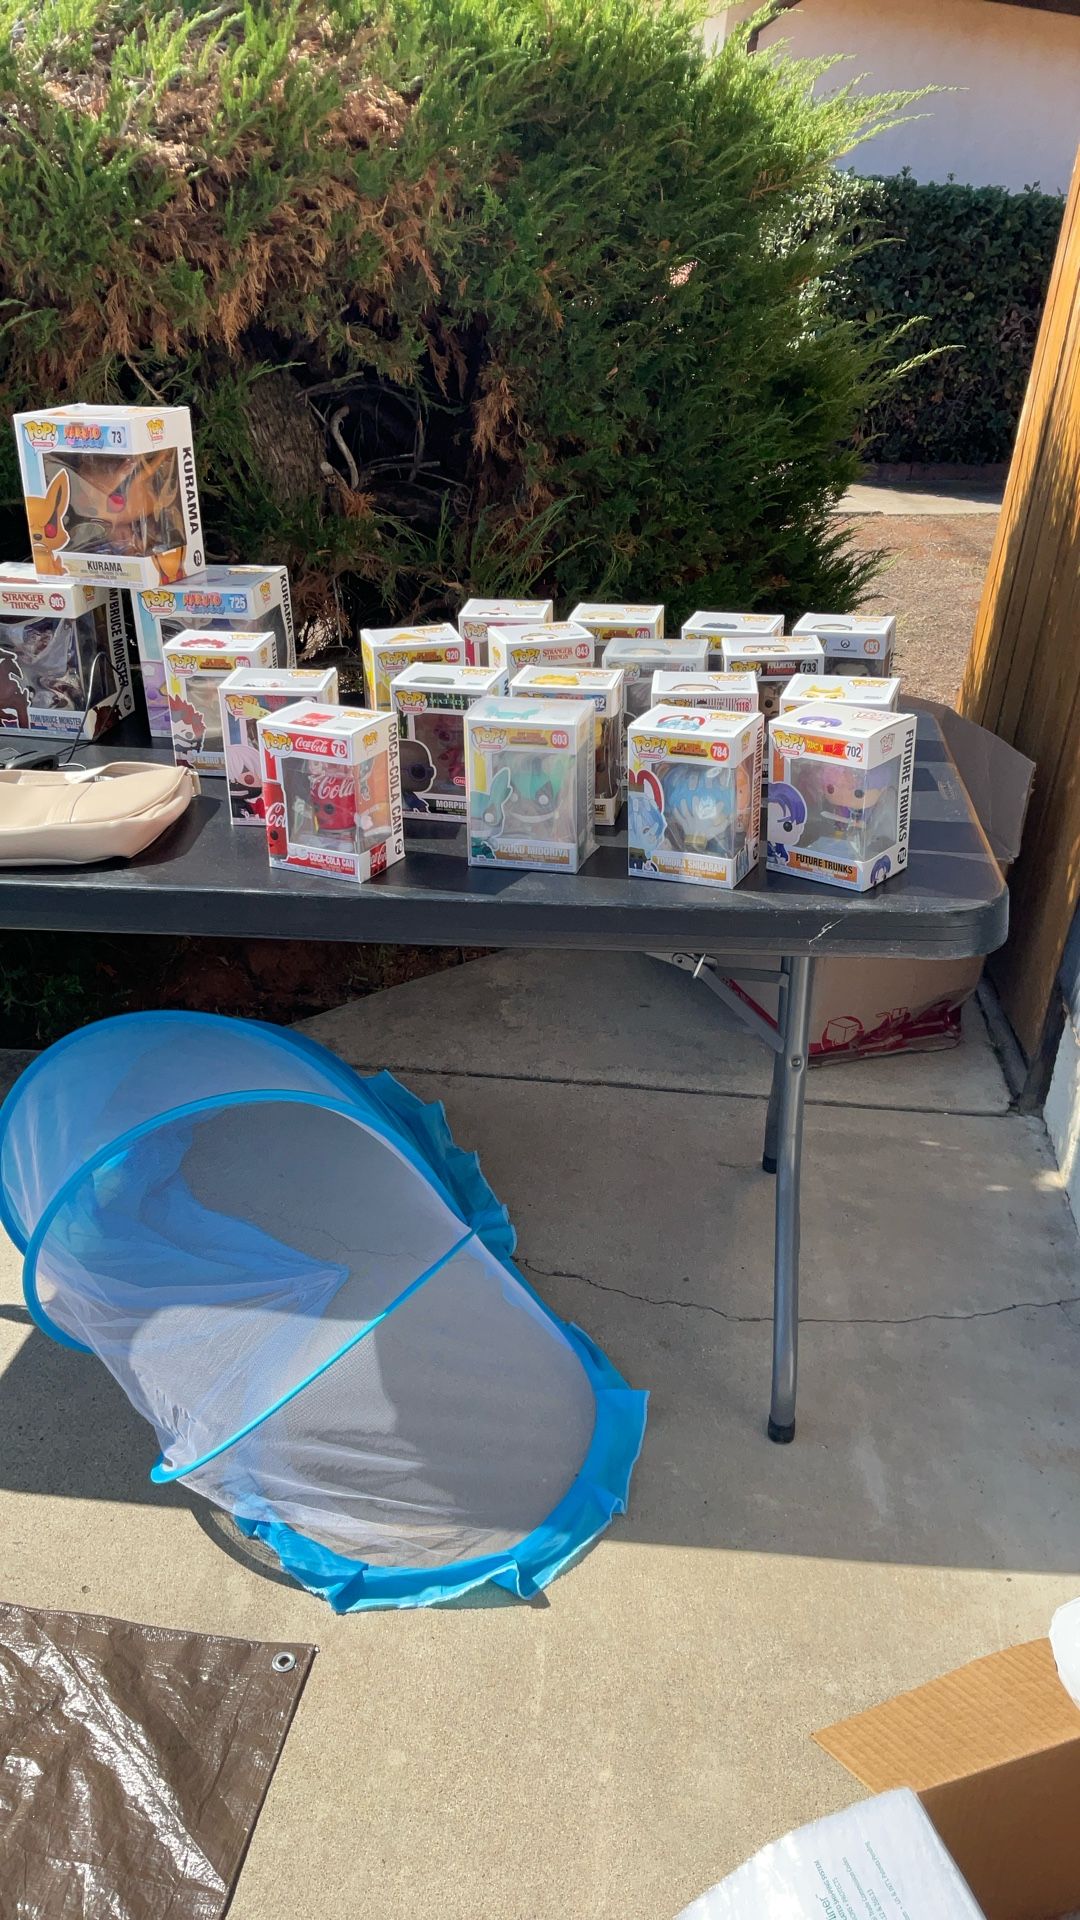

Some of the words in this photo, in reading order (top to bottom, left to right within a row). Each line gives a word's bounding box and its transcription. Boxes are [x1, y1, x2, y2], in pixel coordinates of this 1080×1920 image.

[24, 420, 57, 441] POP!
[111, 431, 122, 444] 73
[182, 446, 199, 535] KURAMA
[86, 560, 123, 573] KURAMA
[2, 591, 45, 605] STRANGER
[51, 597, 64, 609] 903
[141, 590, 175, 608] POP!
[229, 597, 246, 609] 725
[280, 574, 293, 635] KURAMA
[11, 601, 39, 611] THINGS
[377, 651, 409, 665] POP!
[446, 651, 458, 662] 920
[576, 646, 588, 657] 843
[802, 663, 817, 673] 733
[395, 690, 427, 707] POP!
[736, 702, 749, 711] 1118
[262, 731, 291, 751] POP!
[471, 727, 506, 743] POP!
[552, 734, 567, 745] 603
[772, 729, 805, 750] POP!
[333, 742, 347, 754] 78
[632, 736, 667, 754] POP!
[712, 746, 727, 758] 784
[846, 745, 862, 758] 702
[388, 722, 401, 801] COCA-COLA
[902, 728, 914, 784] FUTURE
[391, 804, 402, 835] CAN
[898, 785, 911, 843] TRUNKS
[309, 853, 340, 866] COCA-COLA
[342, 857, 354, 868] CAN
[795, 853, 822, 867] FUTURE
[824, 860, 853, 874] TRUNKS
[814, 1859, 827, 1881] SYSTEM
